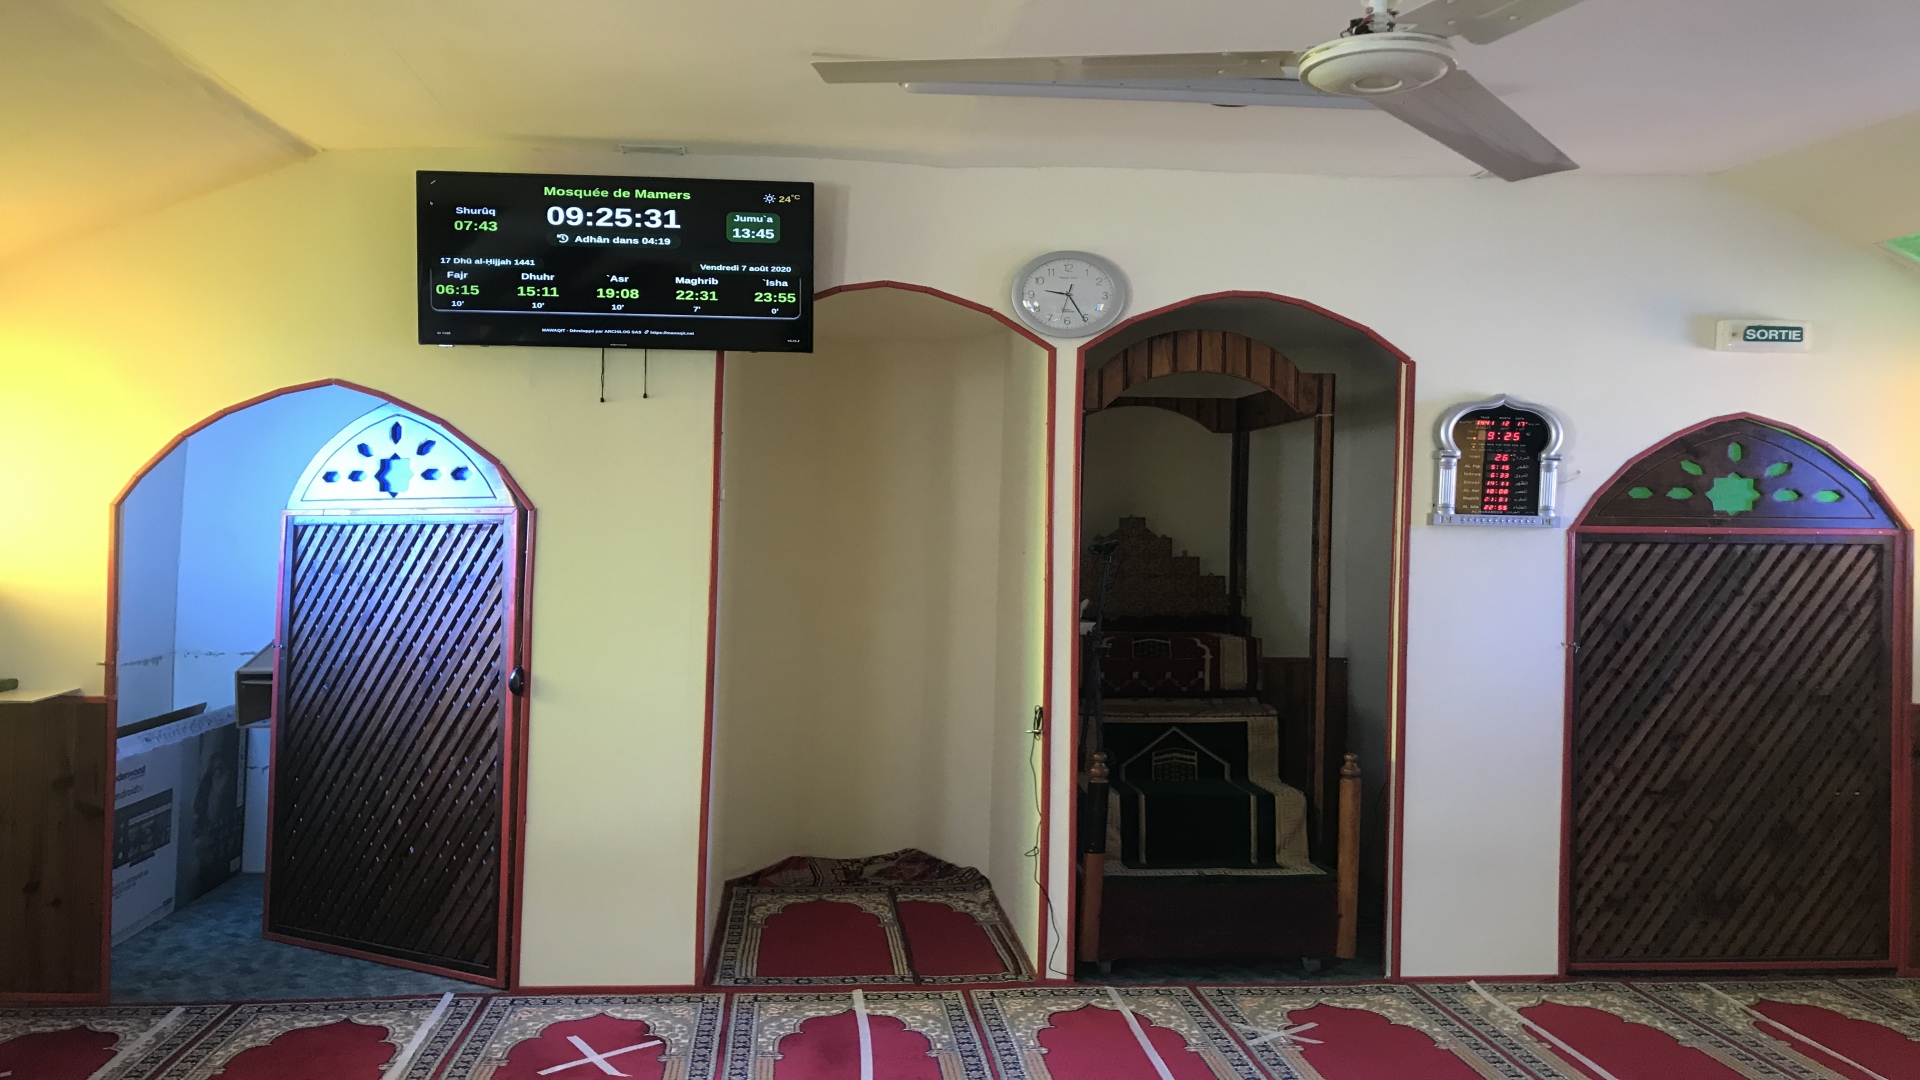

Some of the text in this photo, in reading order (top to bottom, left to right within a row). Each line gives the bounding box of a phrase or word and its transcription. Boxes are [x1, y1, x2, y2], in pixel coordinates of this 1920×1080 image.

[544, 187, 690, 199] Mosquée de Mamers
[456, 207, 495, 216] Shurûq
[547, 206, 680, 228] 09:25:31
[454, 221, 497, 231] 07:43
[733, 228, 774, 239] 13:45
[1047, 268, 1055, 276] 11
[1063, 263, 1073, 272] 12
[447, 271, 468, 280] Fajr
[676, 277, 718, 286] Maghrib
[1035, 276, 1045, 285] 10
[1096, 277, 1103, 286] 2
[436, 285, 479, 295] 06:15
[518, 286, 559, 297] 15:11
[597, 288, 639, 299] 19:08
[1028, 290, 1035, 298] 9
[676, 290, 718, 300] 22:31
[754, 292, 796, 303] 23:55
[1102, 292, 1109, 300] 3
[1046, 314, 1053, 322] 7
[1063, 317, 1071, 325] 6
[1746, 329, 1801, 340] SORTIE
[1487, 431, 1521, 441] 9:25
[1494, 454, 1509, 462] 26
